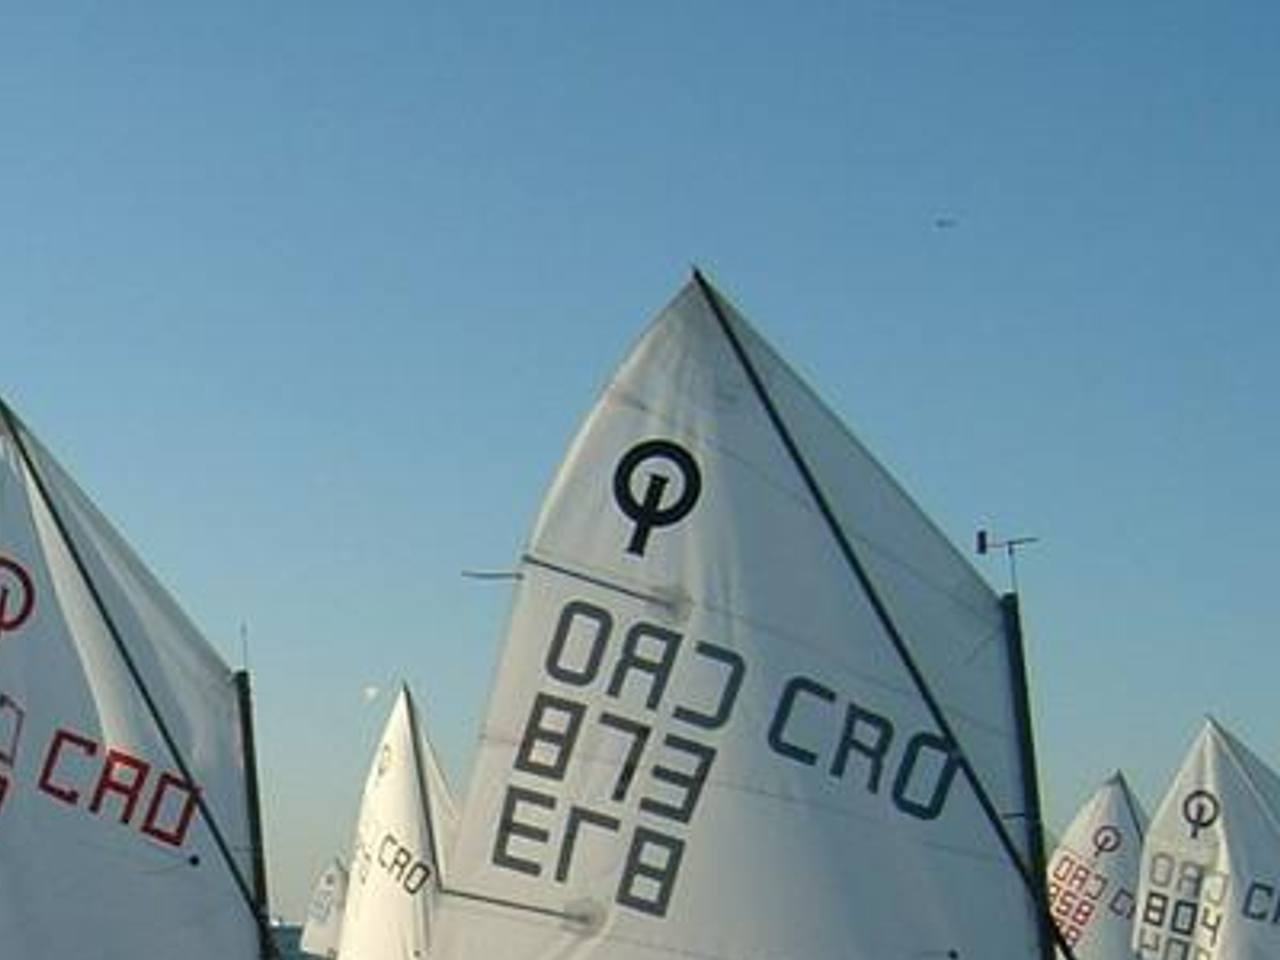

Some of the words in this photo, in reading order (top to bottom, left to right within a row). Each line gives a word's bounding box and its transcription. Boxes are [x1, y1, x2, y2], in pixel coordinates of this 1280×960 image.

[513, 691, 718, 824] 873
[767, 675, 962, 821] CRO
[378, 832, 431, 895] CRO
[1143, 890, 1223, 948] 804
